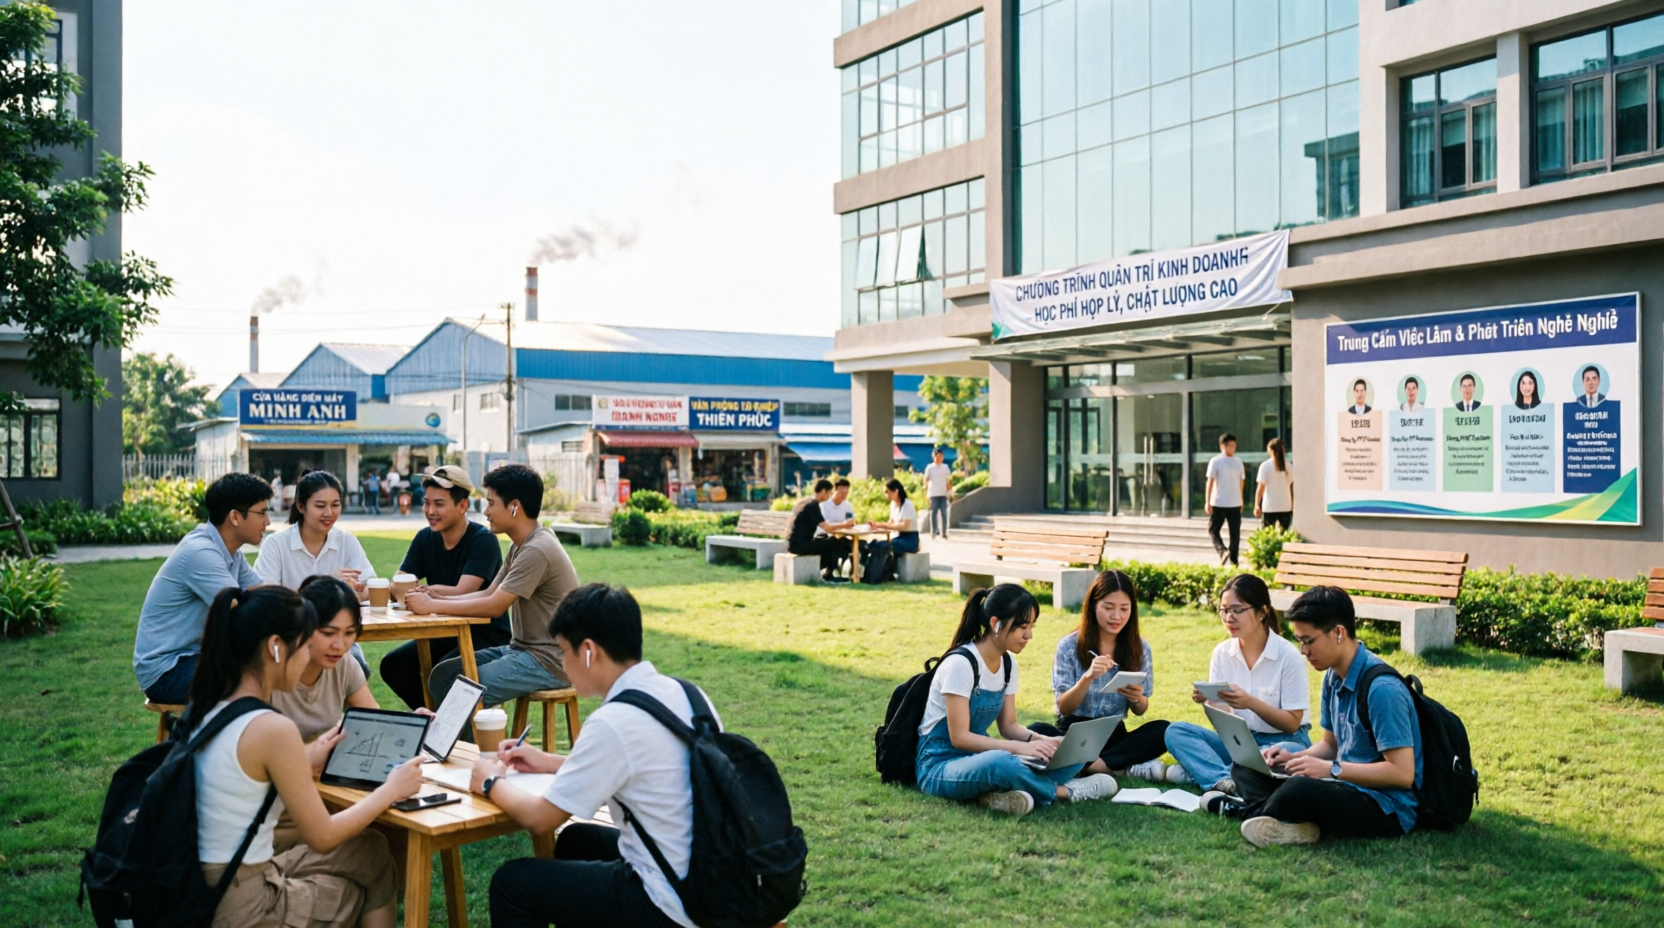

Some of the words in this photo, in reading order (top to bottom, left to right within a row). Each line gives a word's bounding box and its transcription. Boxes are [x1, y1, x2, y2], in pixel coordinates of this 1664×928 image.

[1158, 257, 1188, 279] KINH
[1035, 304, 1057, 326] HỌC
[1060, 297, 1078, 320] PHÍ
[1209, 277, 1238, 299] CAO
[1337, 335, 1369, 353] Trung
[1455, 324, 1465, 342] &
[249, 403, 301, 418] MINH
[307, 404, 346, 420] ANH
